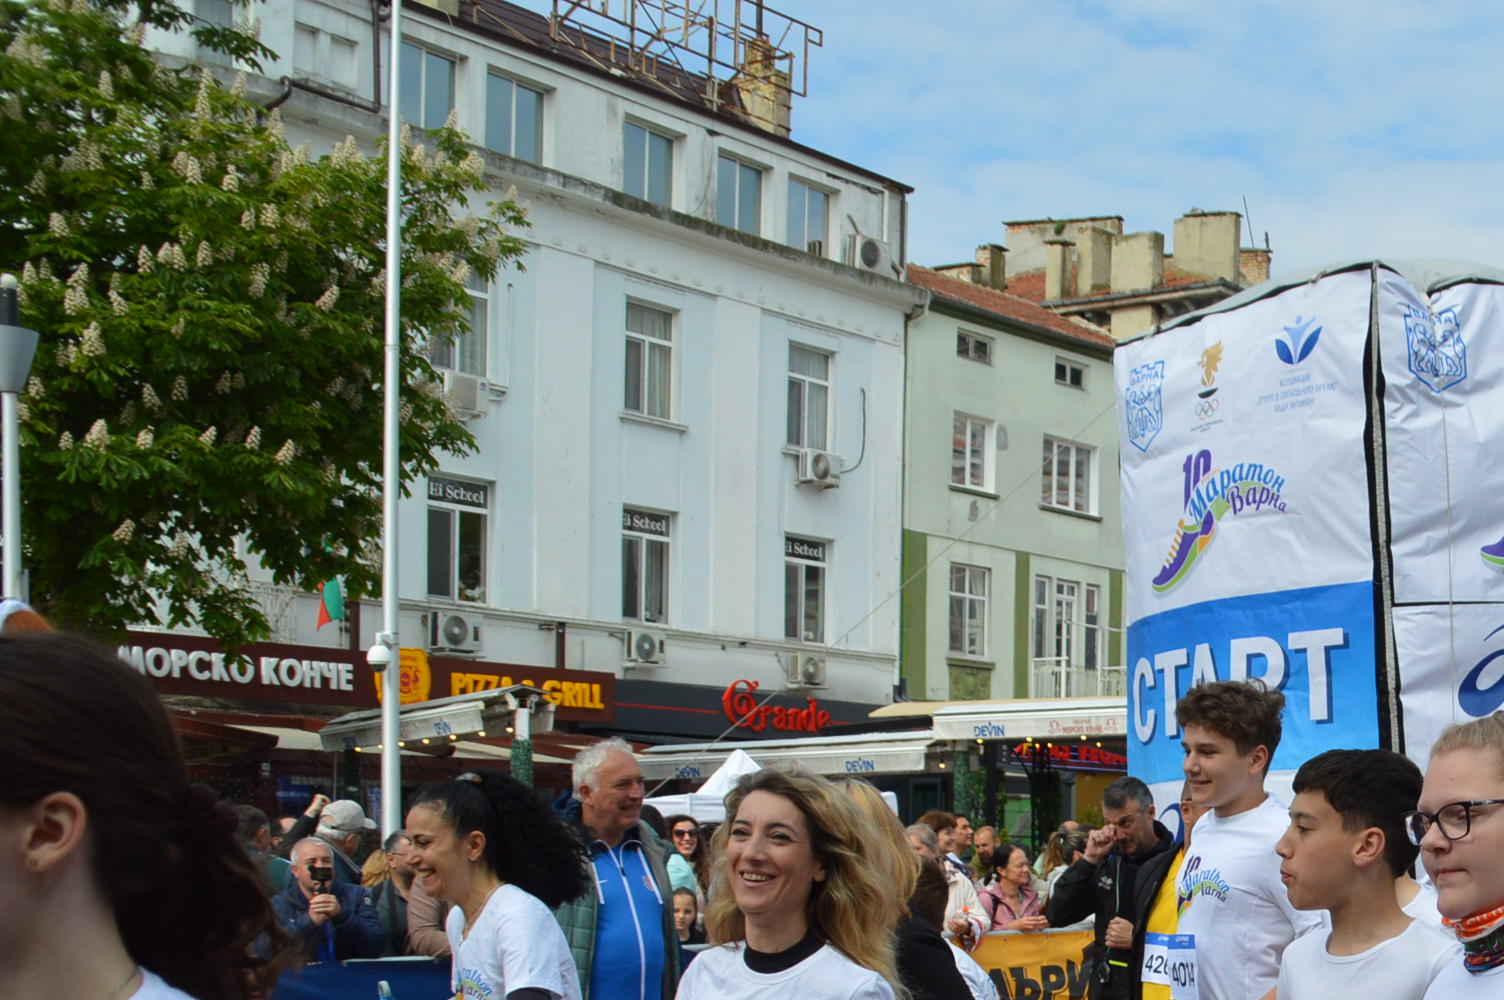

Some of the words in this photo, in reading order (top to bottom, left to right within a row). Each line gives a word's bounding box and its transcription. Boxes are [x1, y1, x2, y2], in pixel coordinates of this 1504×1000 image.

[446, 485, 485, 504] School
[1189, 463, 1285, 525] Маратон
[1227, 485, 1287, 516] Варна
[632, 514, 667, 533] School
[793, 542, 822, 558] School
[118, 645, 255, 684] МОРСКО
[259, 656, 354, 691] КОНЧЕ
[542, 679, 605, 710] GRILL
[721, 679, 832, 733] Grande
[974, 721, 1005, 737] DEVIN
[844, 758, 875, 772] DEVIN
[1183, 868, 1230, 894] Marathon
